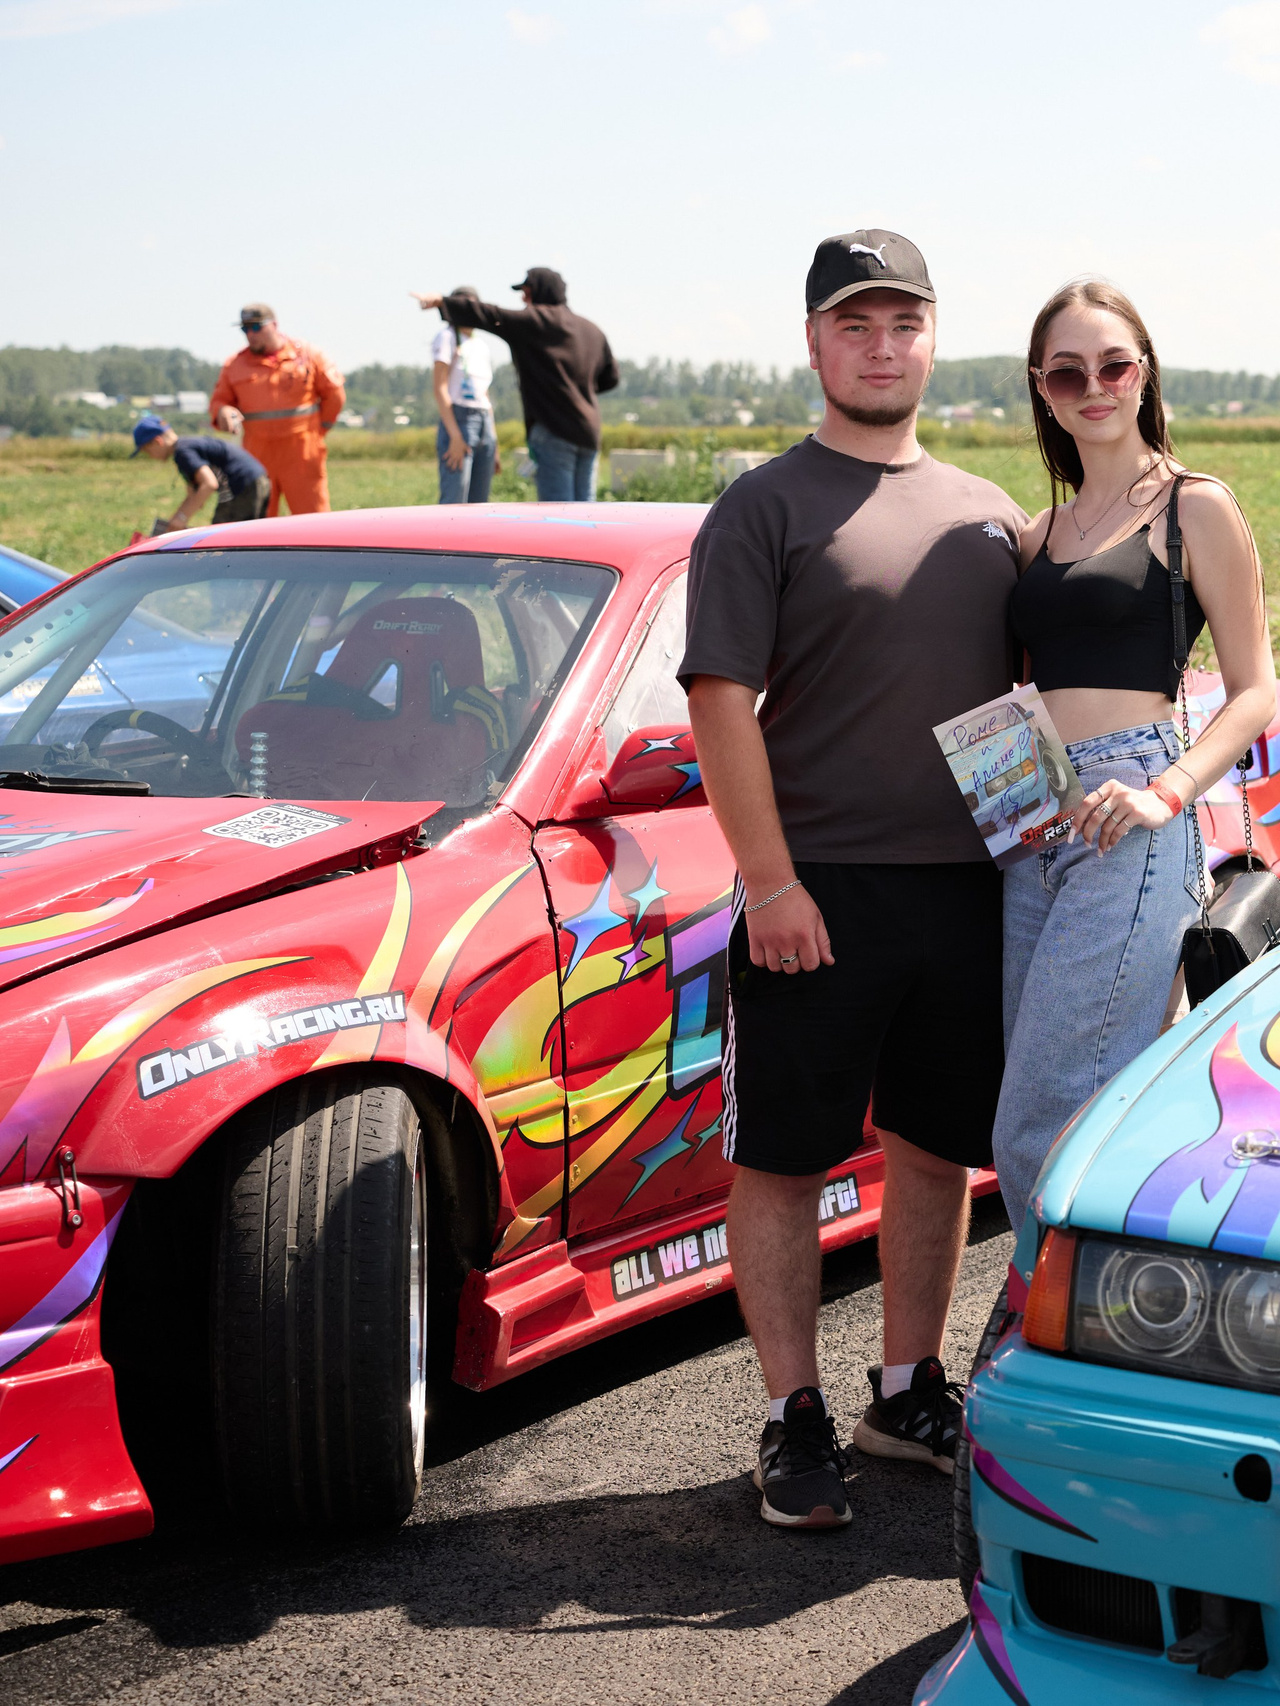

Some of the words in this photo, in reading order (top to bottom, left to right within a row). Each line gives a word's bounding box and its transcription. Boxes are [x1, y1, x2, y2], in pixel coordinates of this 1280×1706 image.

[953, 716, 997, 753] Роме
[1020, 812, 1062, 845] DRIFT
[1044, 815, 1075, 841] REA
